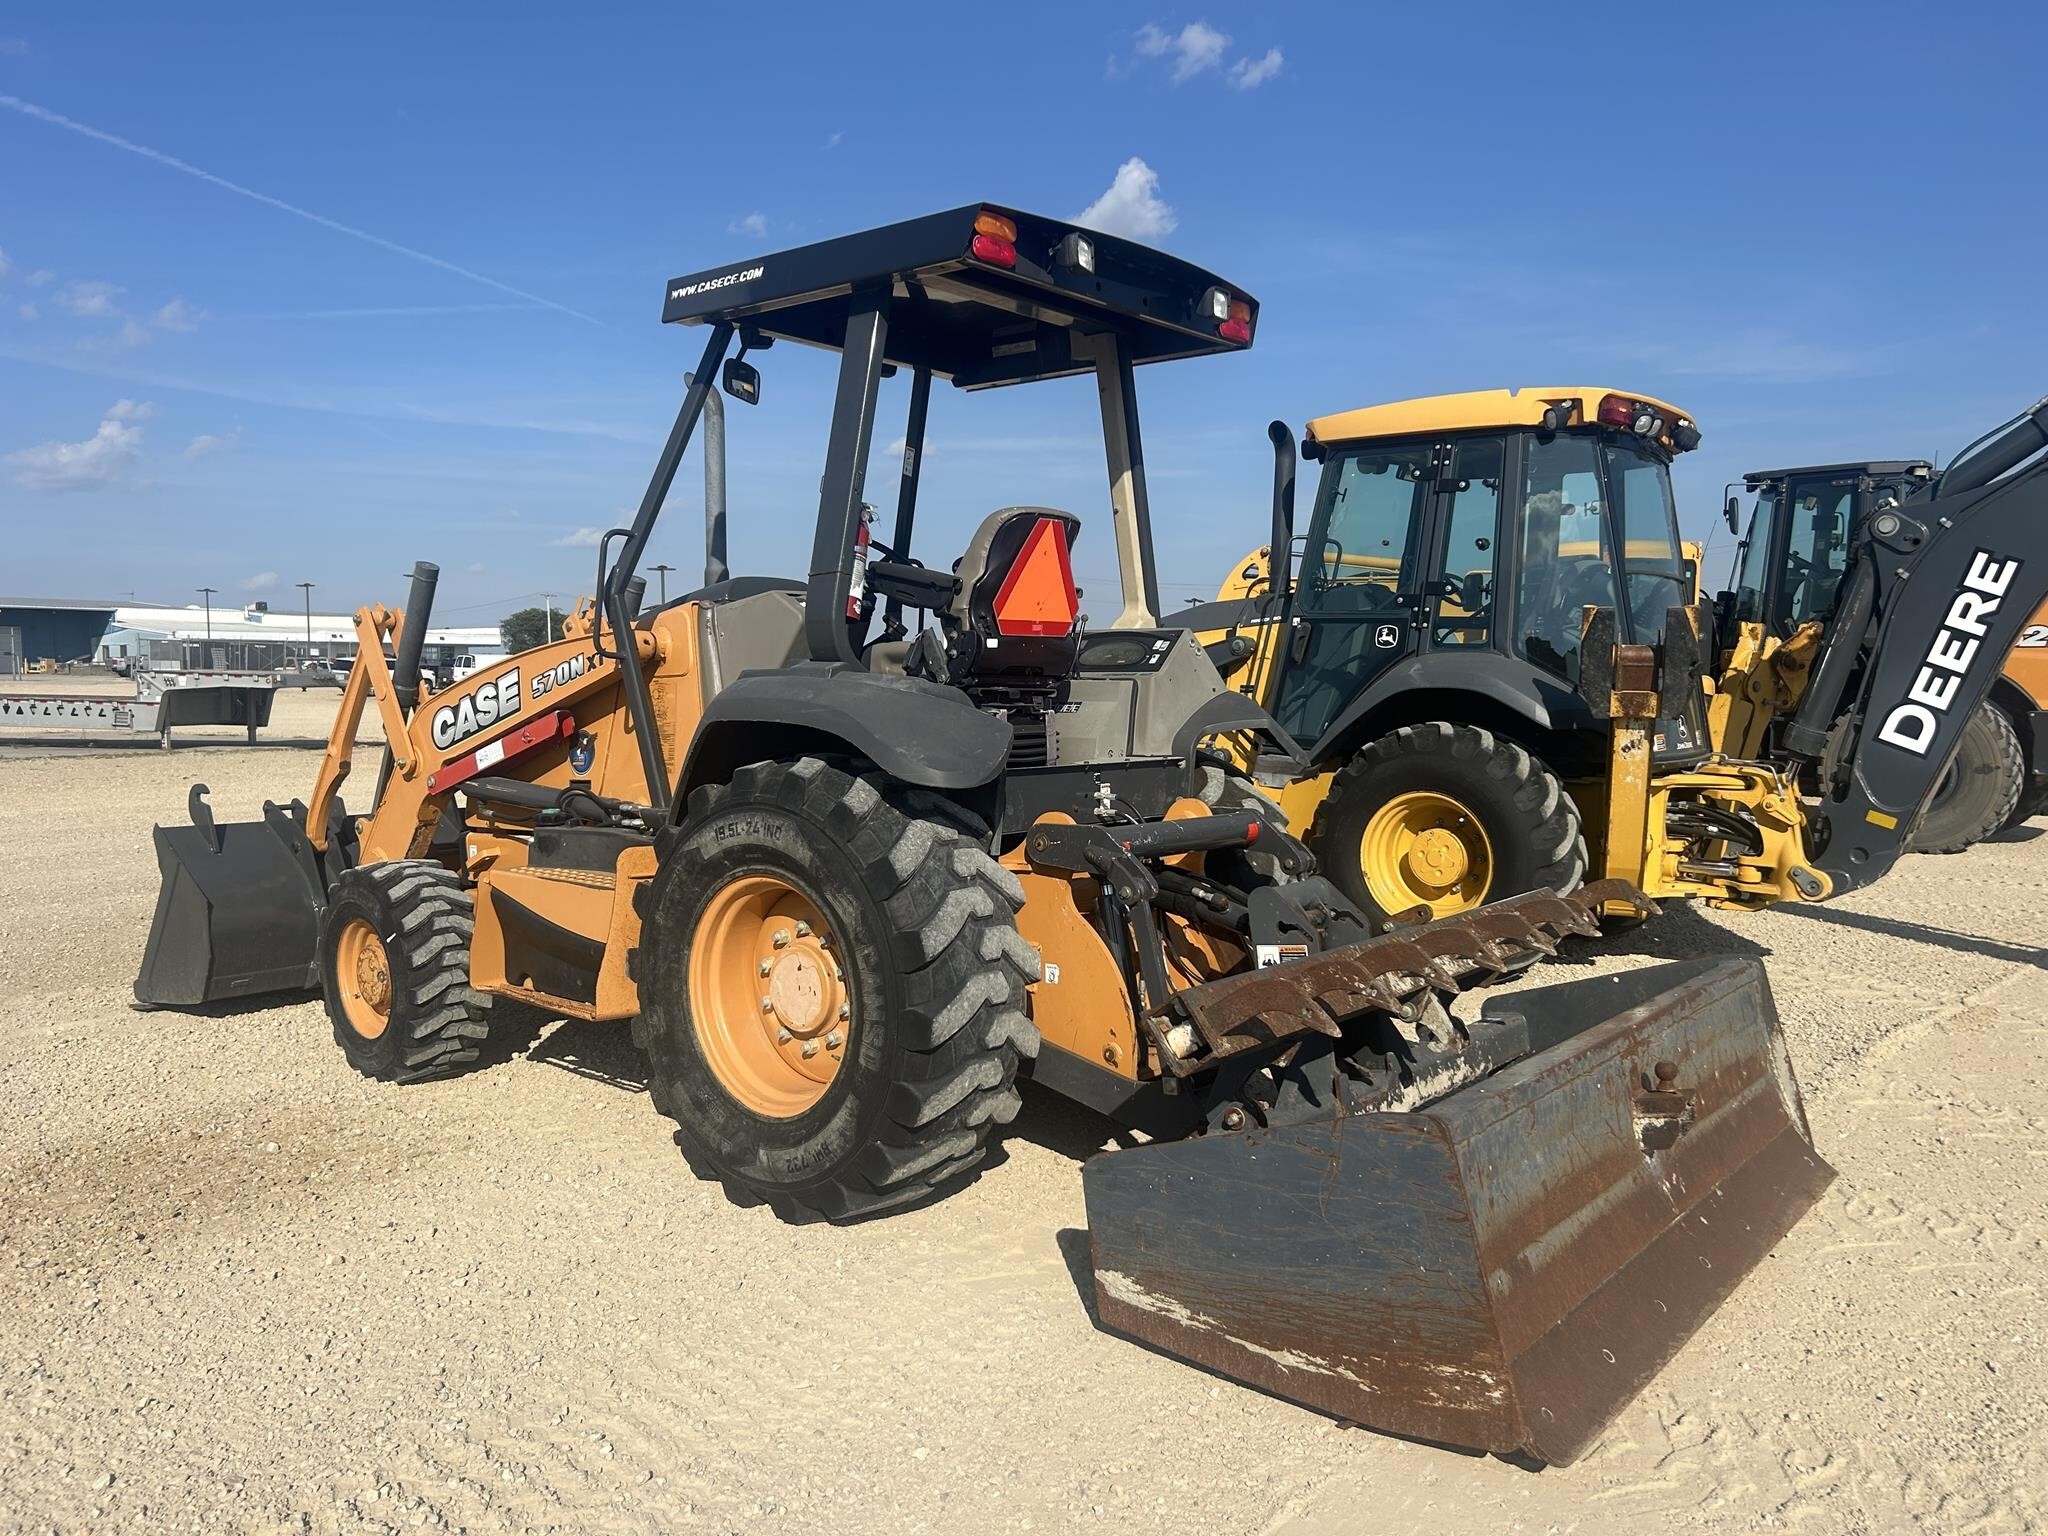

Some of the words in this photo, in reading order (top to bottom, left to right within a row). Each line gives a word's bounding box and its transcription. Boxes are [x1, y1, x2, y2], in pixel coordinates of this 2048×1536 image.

[670, 266, 765, 301] WWW.CASECE.COM
[1878, 551, 2019, 755] DEERE
[432, 667, 522, 750] CASE
